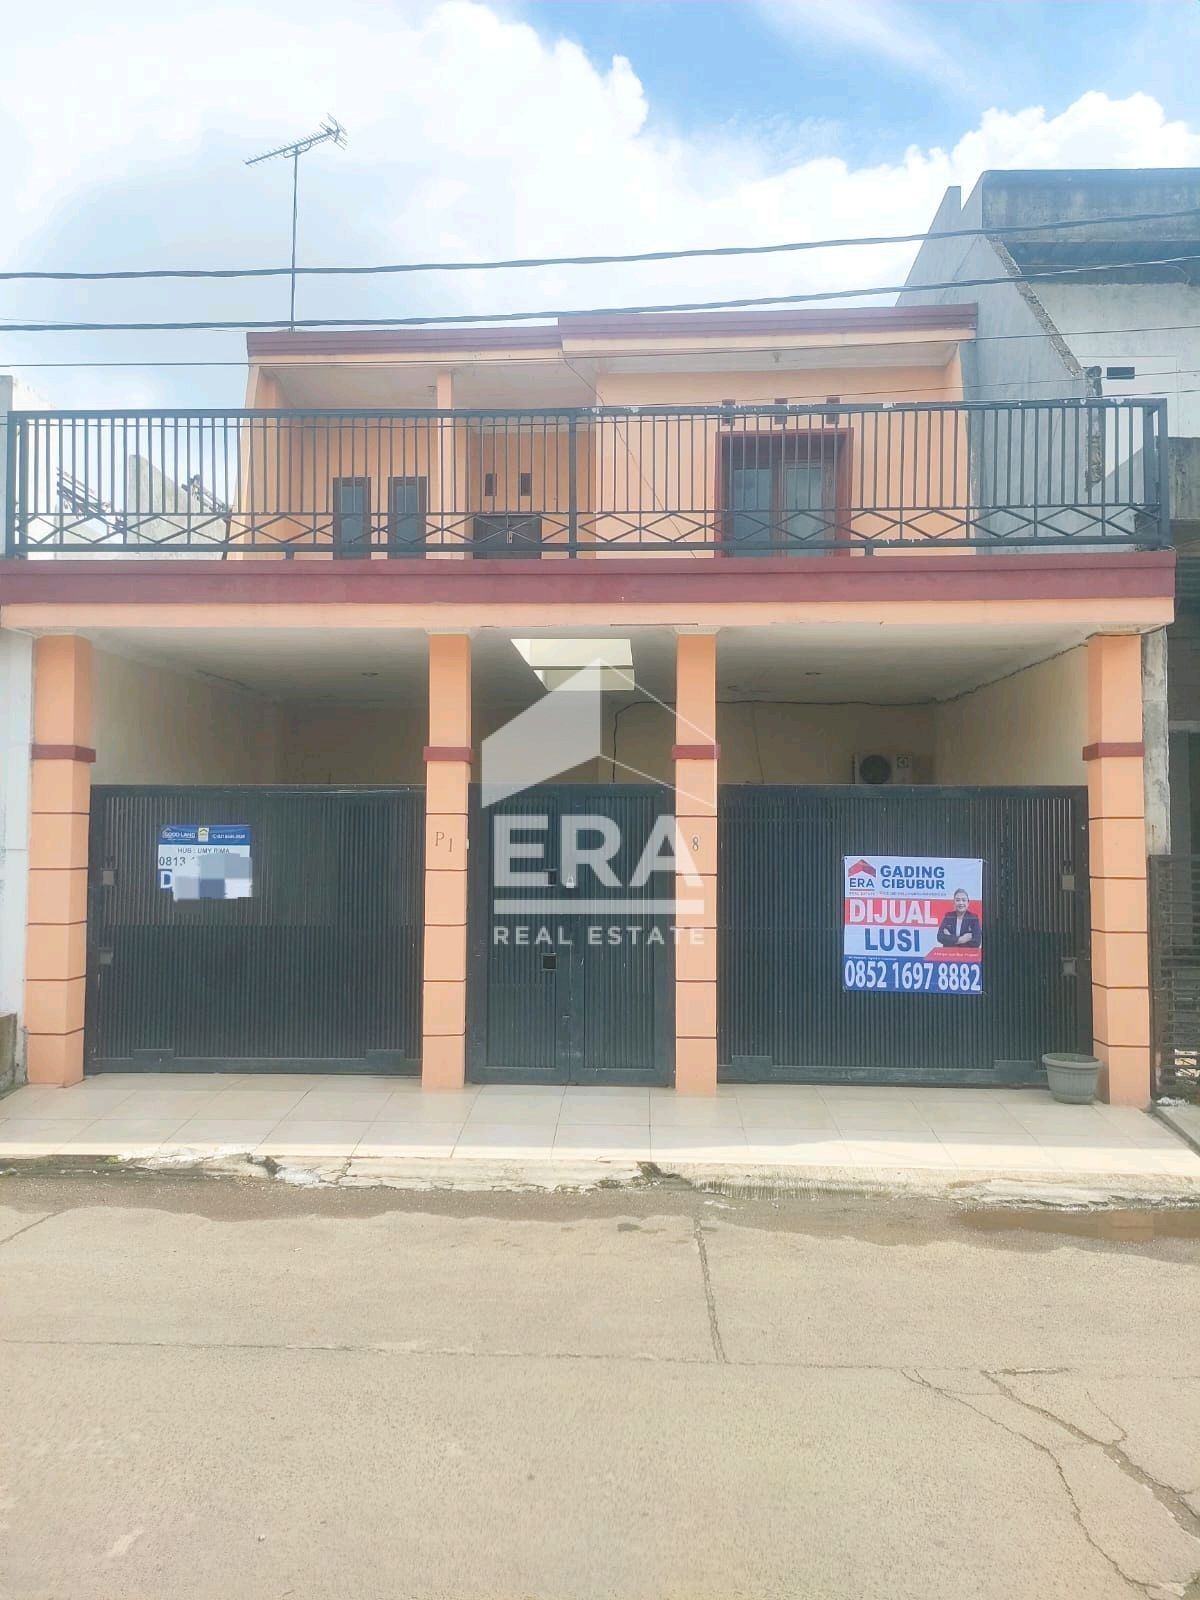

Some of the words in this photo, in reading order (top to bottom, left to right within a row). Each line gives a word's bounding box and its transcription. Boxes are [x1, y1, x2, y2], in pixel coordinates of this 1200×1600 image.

[692, 836, 699, 852] 8
[158, 856, 186, 867] 0813
[880, 865, 945, 879] GADING
[849, 878, 875, 888] ERA
[881, 879, 946, 890] CIBUBUR
[849, 898, 939, 925] DIJUAL
[864, 927, 920, 952] LUSI
[844, 960, 887, 988] 0852
[892, 962, 934, 990] 1697
[938, 963, 981, 991] 8882
